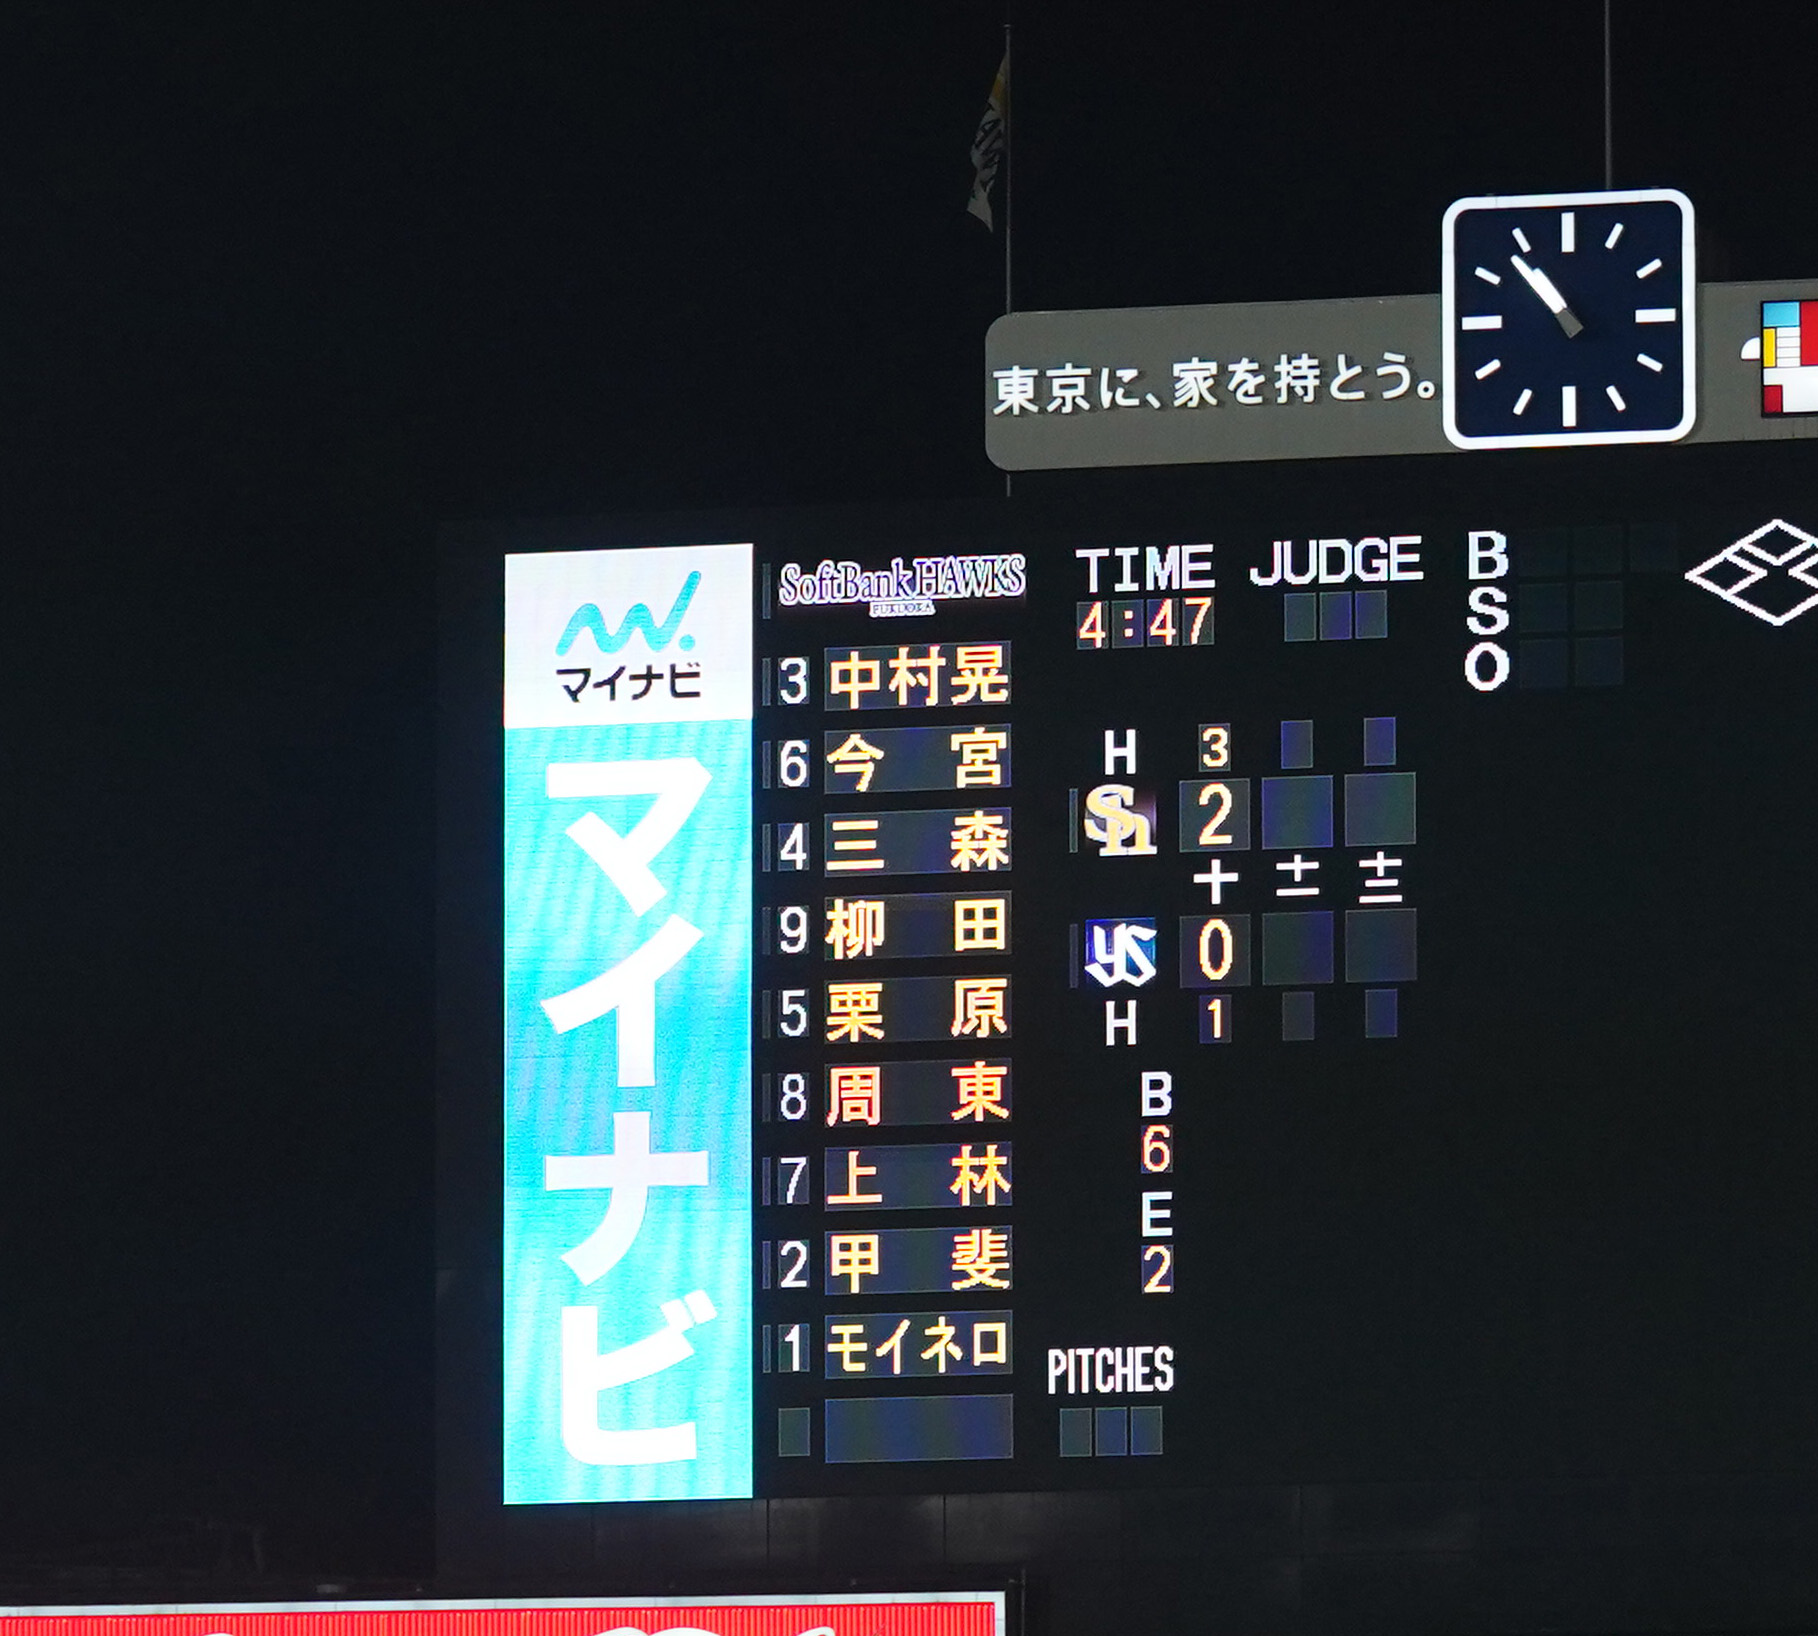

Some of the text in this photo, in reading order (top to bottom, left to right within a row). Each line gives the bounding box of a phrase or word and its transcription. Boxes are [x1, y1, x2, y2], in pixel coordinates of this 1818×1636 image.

[993, 352, 1436, 415] 東京に、家を持とう。
[780, 553, 1026, 605] SoftBank HAWKS
[1076, 536, 1423, 592] TIME JUDGE
[1469, 531, 1508, 579] B
[1079, 597, 1211, 648] 4:47
[1467, 587, 1509, 635] S
[556, 663, 701, 702] マイナビ
[781, 645, 1008, 709] 3 中村晃
[781, 727, 1006, 791] 6 今宮
[1105, 727, 1227, 774] H 3
[781, 810, 1008, 871] 4 三森
[1199, 783, 1232, 844] 2
[781, 899, 1005, 959] 9 柳田
[1200, 919, 1232, 979] 0
[781, 978, 1007, 1042] 5 栗原
[1106, 999, 1220, 1045] H 1
[541, 757, 717, 1466] マイナビ
[781, 1061, 1009, 1126] 8 周東
[1142, 1072, 1171, 1116] B
[1143, 1125, 1169, 1171] 6
[781, 1145, 1011, 1206] 7 上林
[1142, 1192, 1172, 1236] E
[781, 1241, 807, 1287] 2
[1144, 1245, 1170, 1292] 2
[785, 1316, 1006, 1374] 1 モイネロ
[1049, 1346, 1173, 1394] PITCHES
